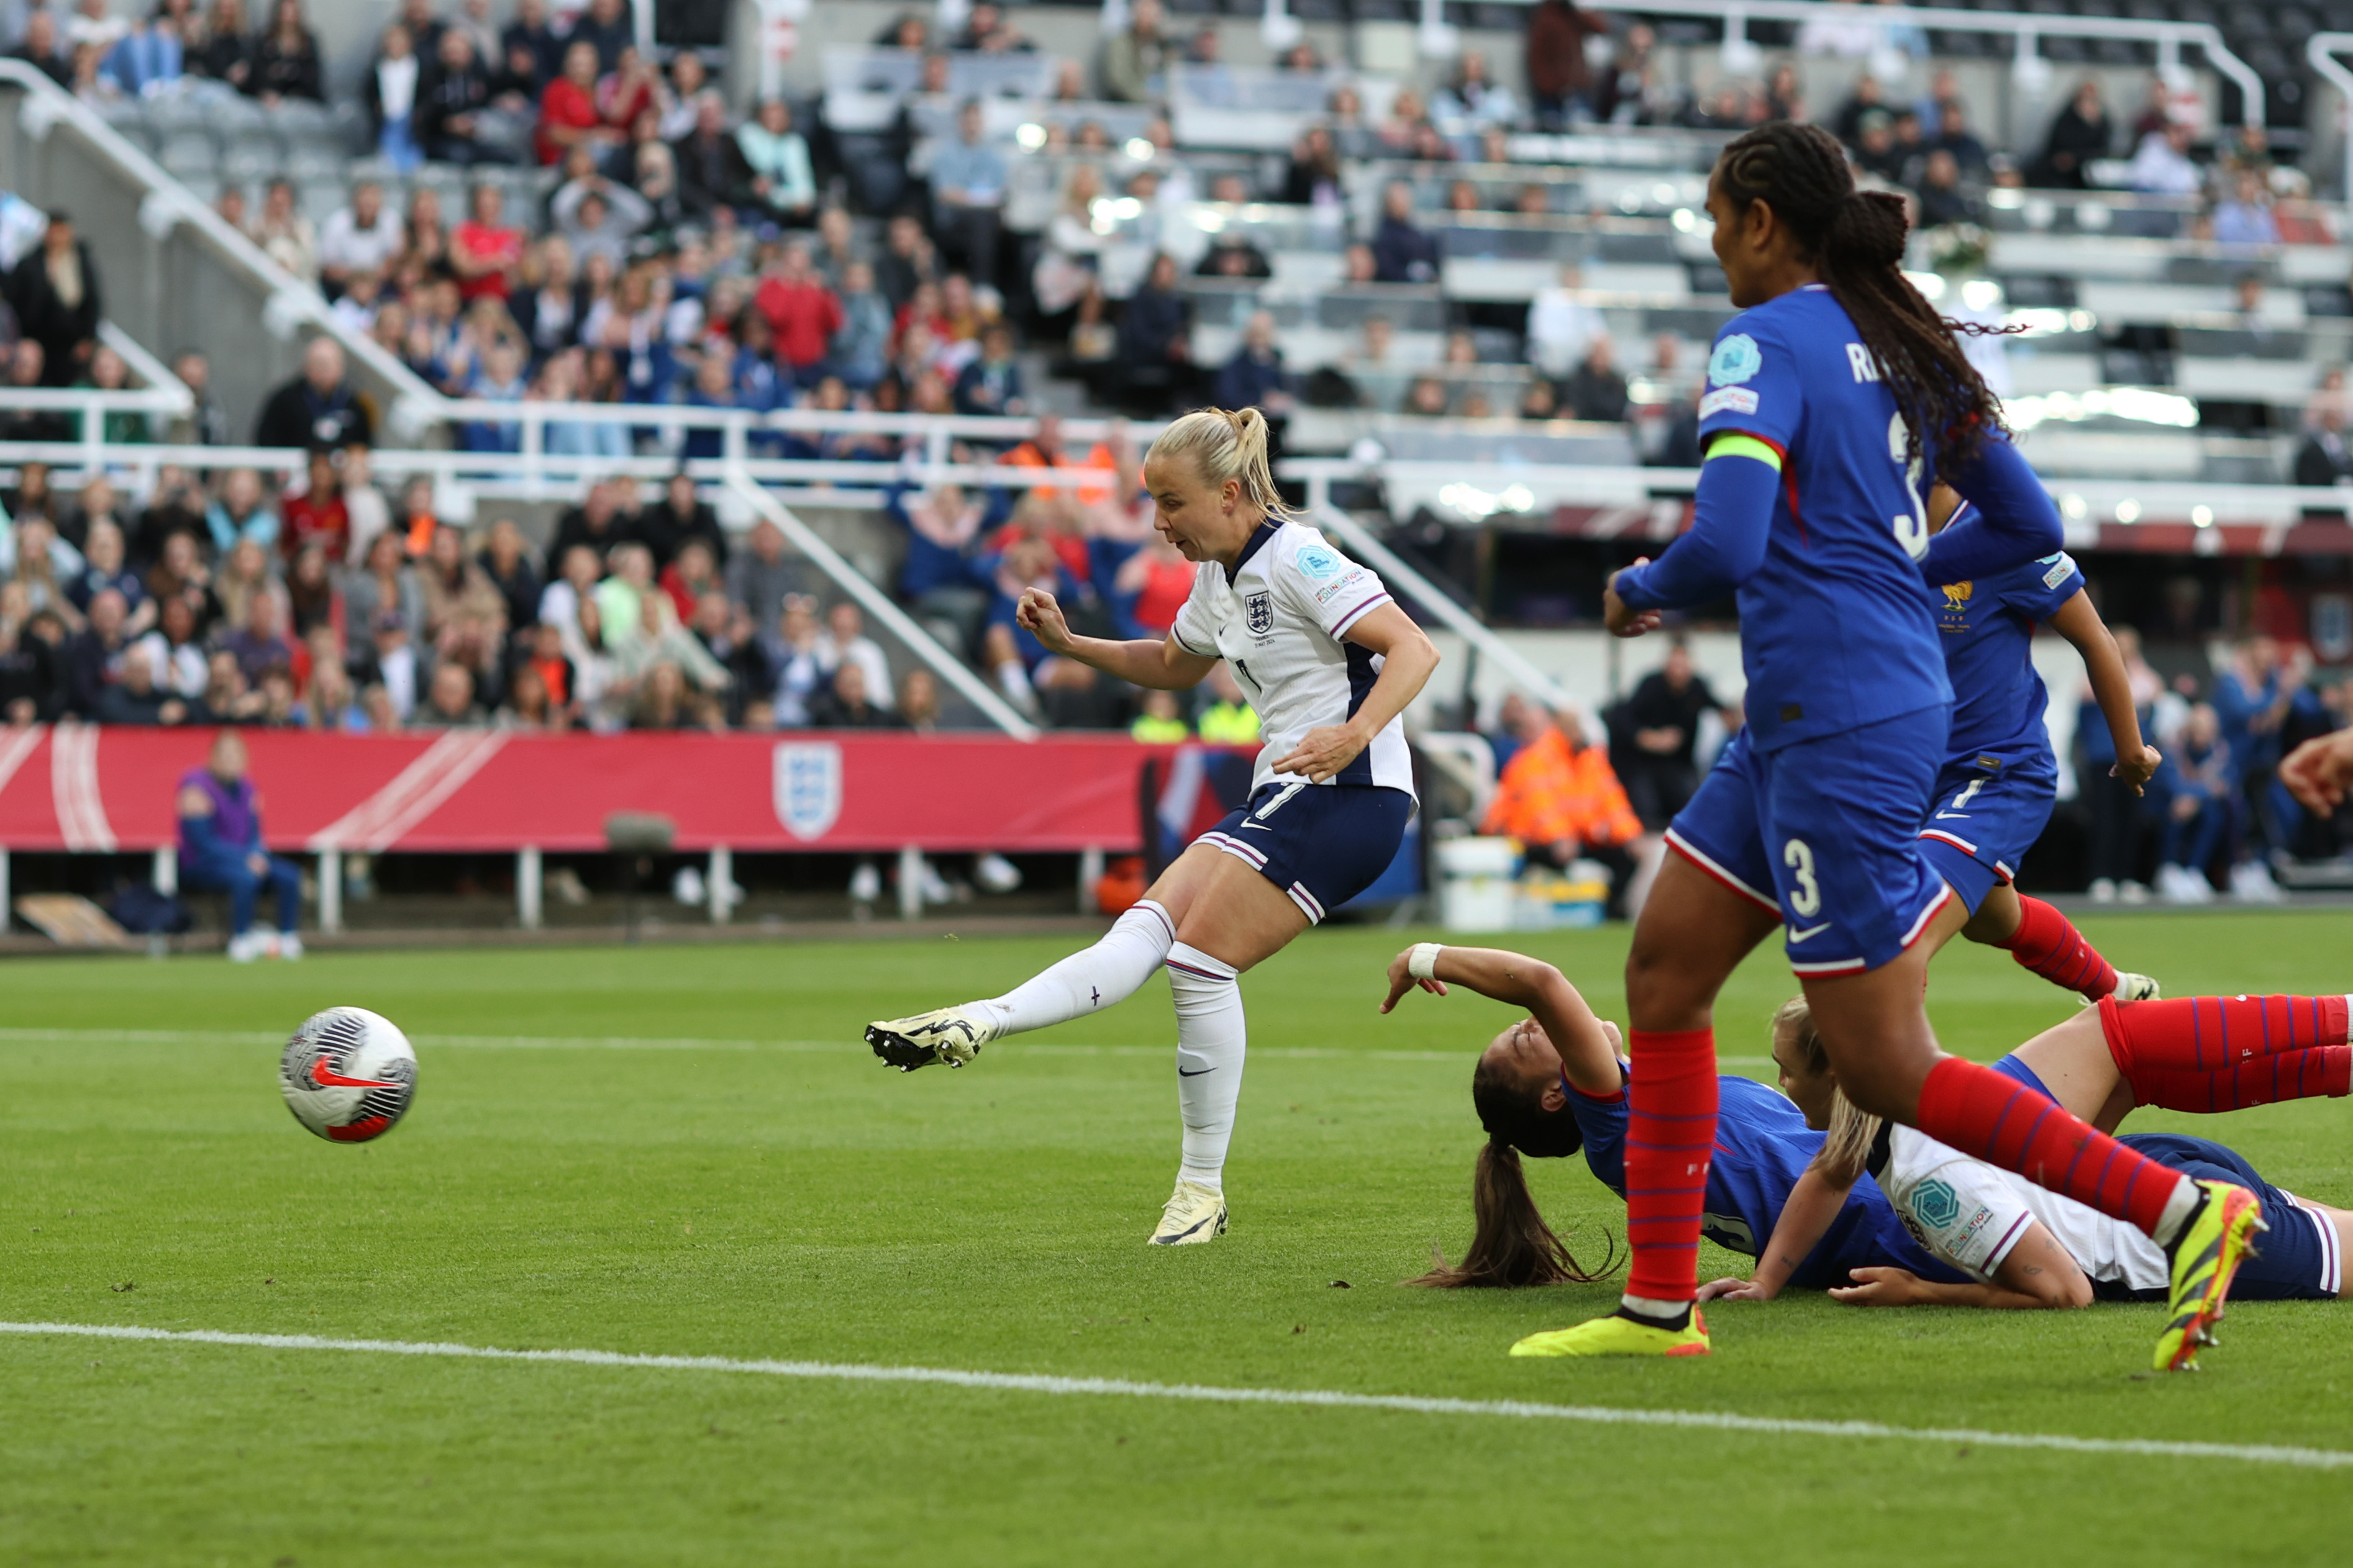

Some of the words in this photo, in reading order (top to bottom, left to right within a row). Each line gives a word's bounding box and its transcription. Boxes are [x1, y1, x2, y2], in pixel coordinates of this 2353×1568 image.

[1317, 569, 1362, 603] FOUNDATION
[1784, 838, 1821, 918] 3
[1948, 1206, 1989, 1254] FOUNDATION
